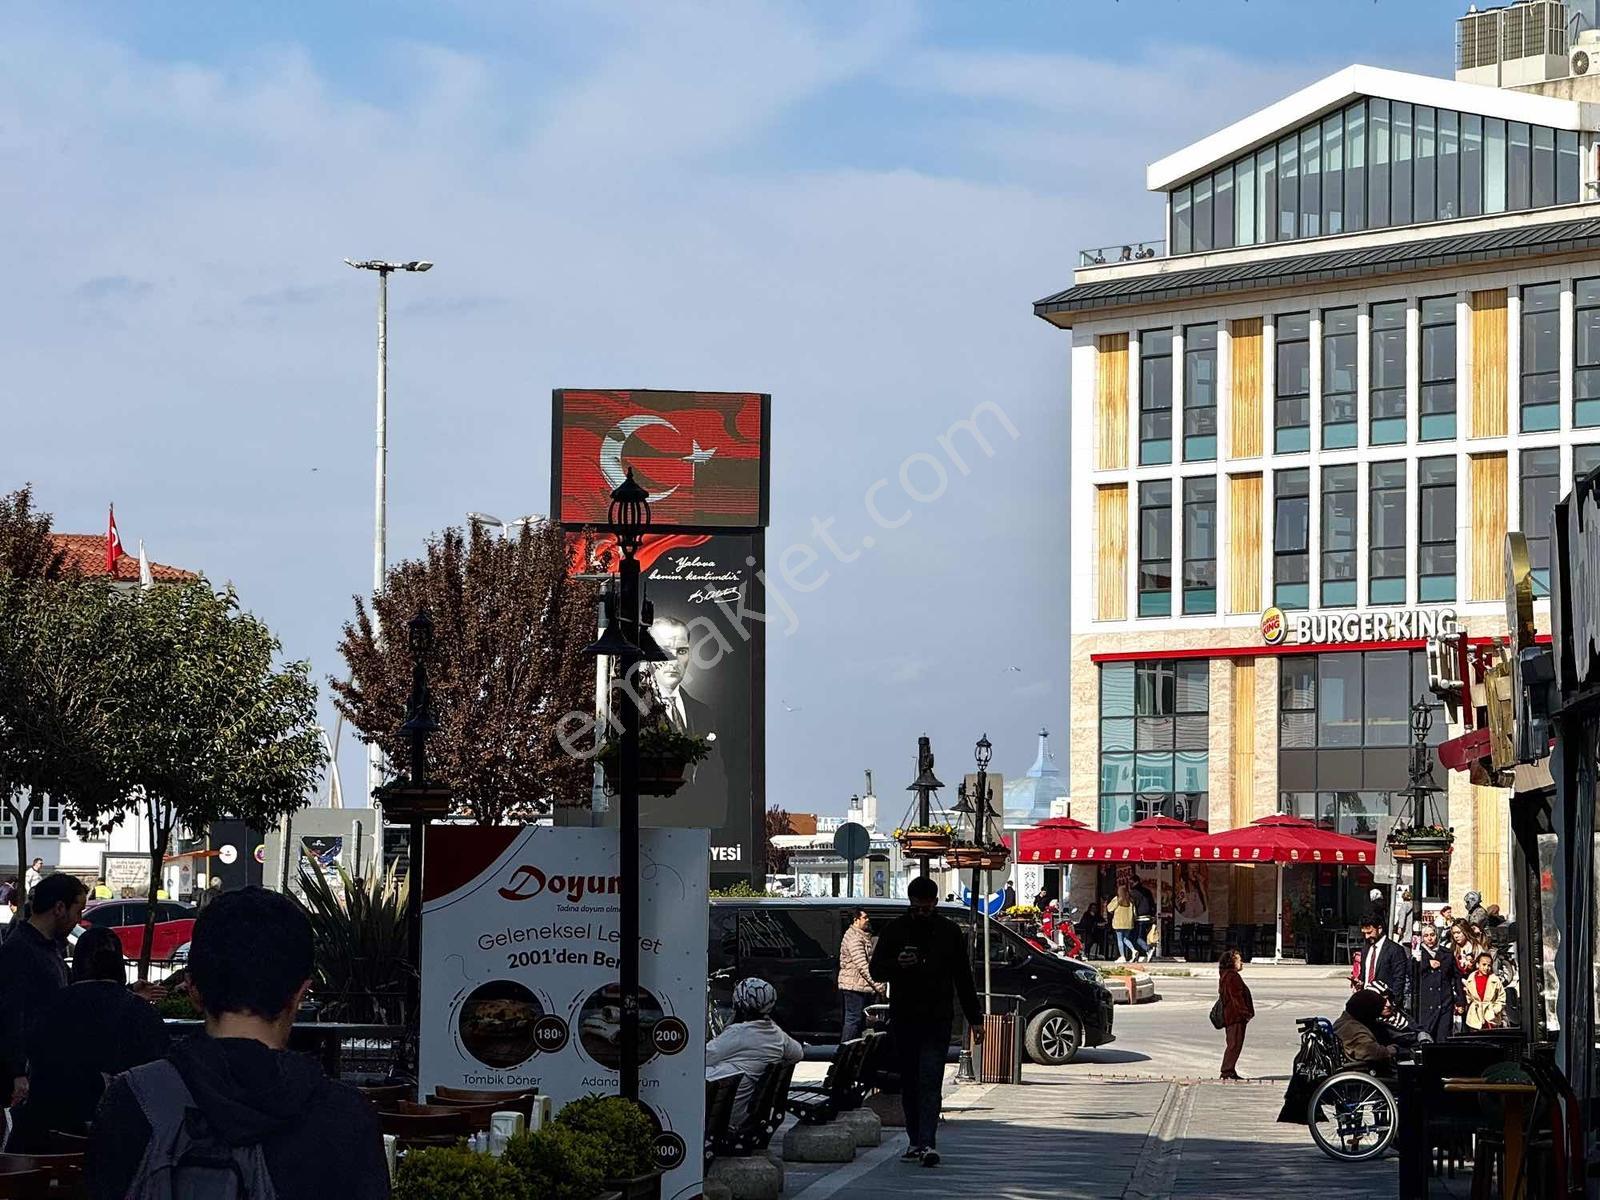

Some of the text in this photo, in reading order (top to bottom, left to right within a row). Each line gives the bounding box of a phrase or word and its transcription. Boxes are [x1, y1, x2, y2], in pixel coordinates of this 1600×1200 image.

[648, 569, 682, 580] benim
[1263, 620, 1280, 634] KING
[1297, 609, 1457, 643] BURGER KING
[710, 844, 741, 861] YESİ
[478, 923, 662, 954] Geleneksel Leet
[507, 949, 588, 969] 2001’den
[463, 1073, 504, 1085] Tombik
[581, 1076, 619, 1088] Adana
